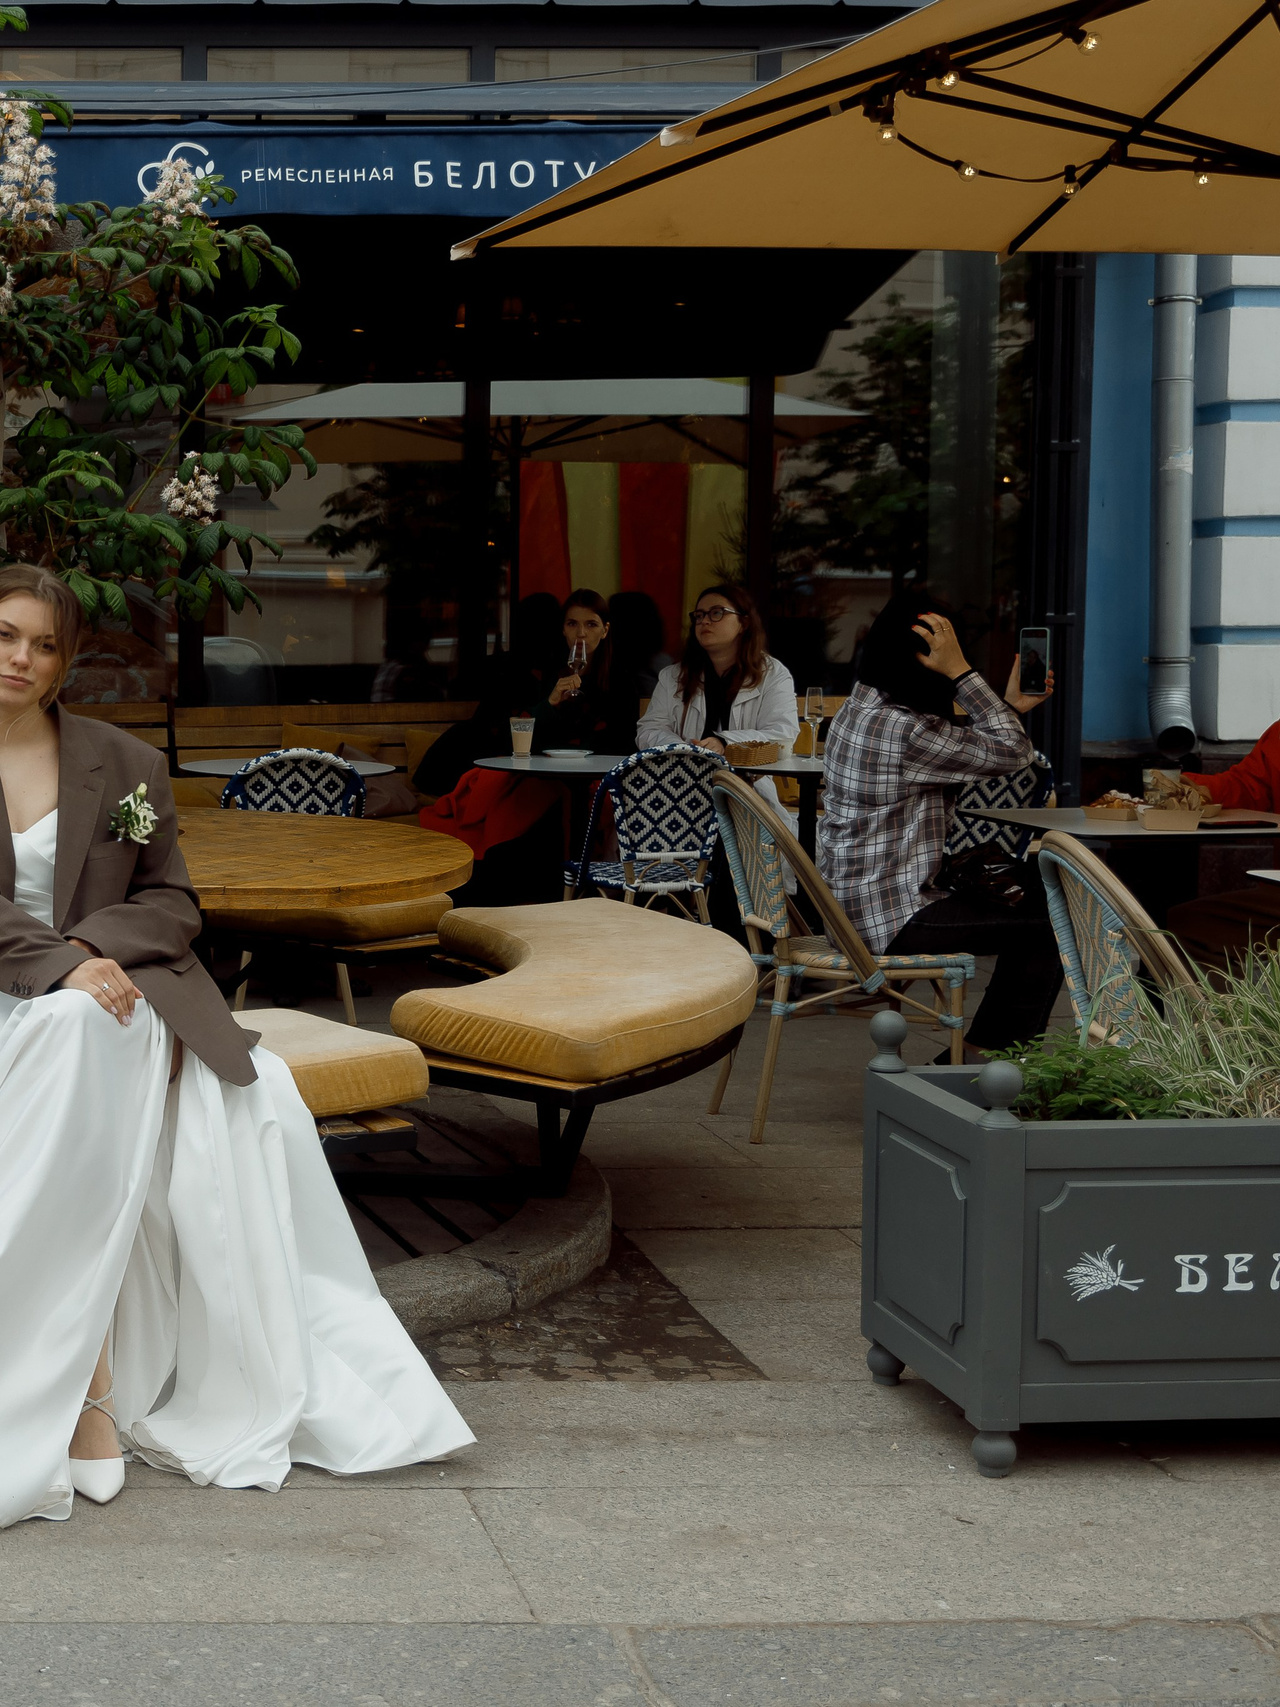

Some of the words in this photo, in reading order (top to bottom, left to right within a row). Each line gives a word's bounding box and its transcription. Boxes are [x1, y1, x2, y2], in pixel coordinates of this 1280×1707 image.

[241, 167, 394, 183] РЕМЕСЛЕННАЯ
[414, 160, 617, 189] БЕЛОТУ
[1174, 1252, 1280, 1293] БЕ
